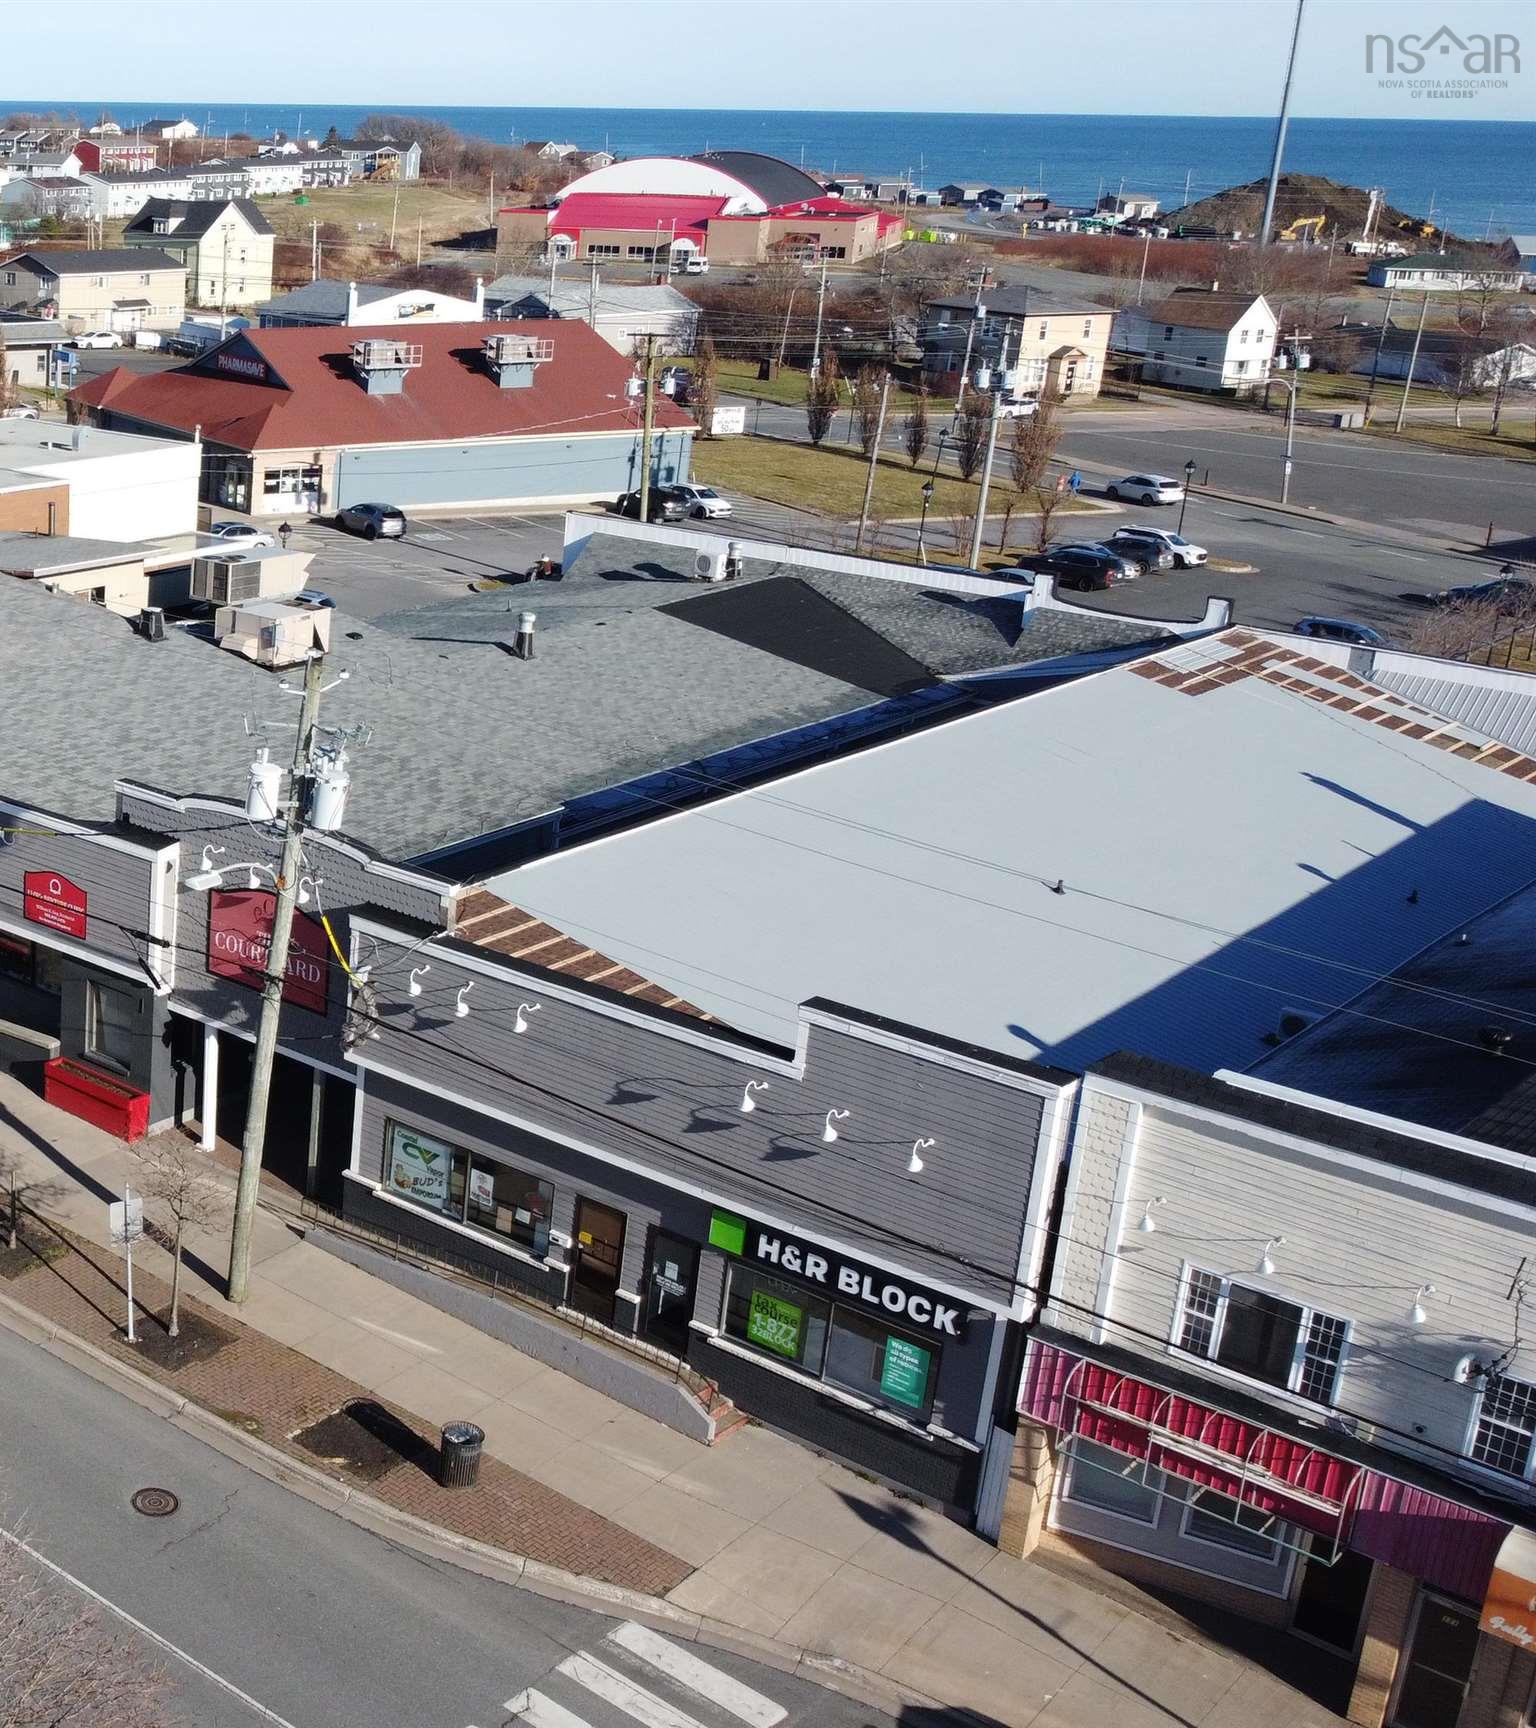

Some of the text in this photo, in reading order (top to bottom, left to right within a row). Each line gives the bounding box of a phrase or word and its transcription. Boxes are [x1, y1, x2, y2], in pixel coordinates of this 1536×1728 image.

[218, 354, 265, 377] PHARMASAVE
[757, 1234, 960, 1336] H&R BLOCK
[756, 1294, 777, 1308] tax
[754, 1304, 798, 1328] course
